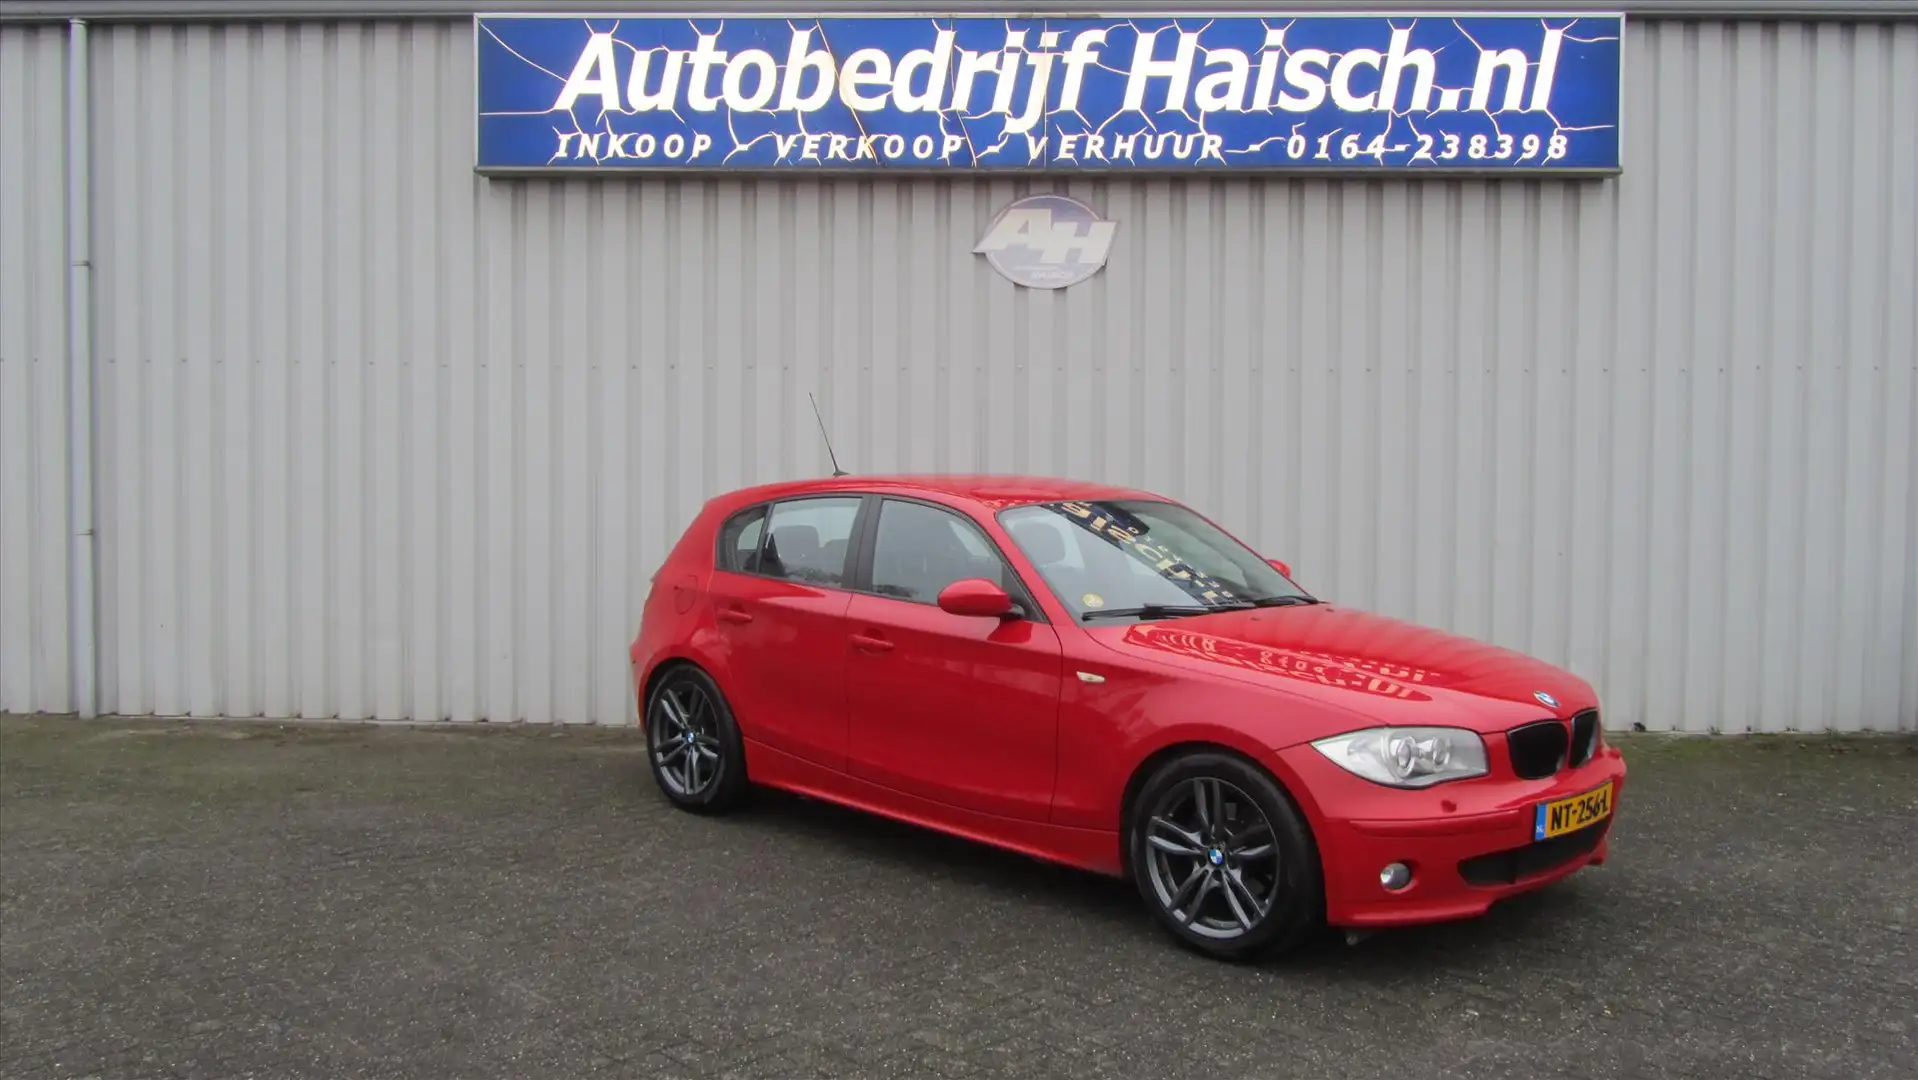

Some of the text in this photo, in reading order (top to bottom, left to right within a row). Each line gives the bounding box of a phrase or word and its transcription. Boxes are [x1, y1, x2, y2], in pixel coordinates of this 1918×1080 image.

[553, 29, 1562, 134] Autobedrijf Haisch.nl
[554, 134, 712, 158] INKOOP
[775, 134, 962, 158] VERKOOP
[1027, 134, 1223, 159] VERHUUR
[1287, 133, 1568, 159] 0164-238398
[973, 208, 1117, 264] AH
